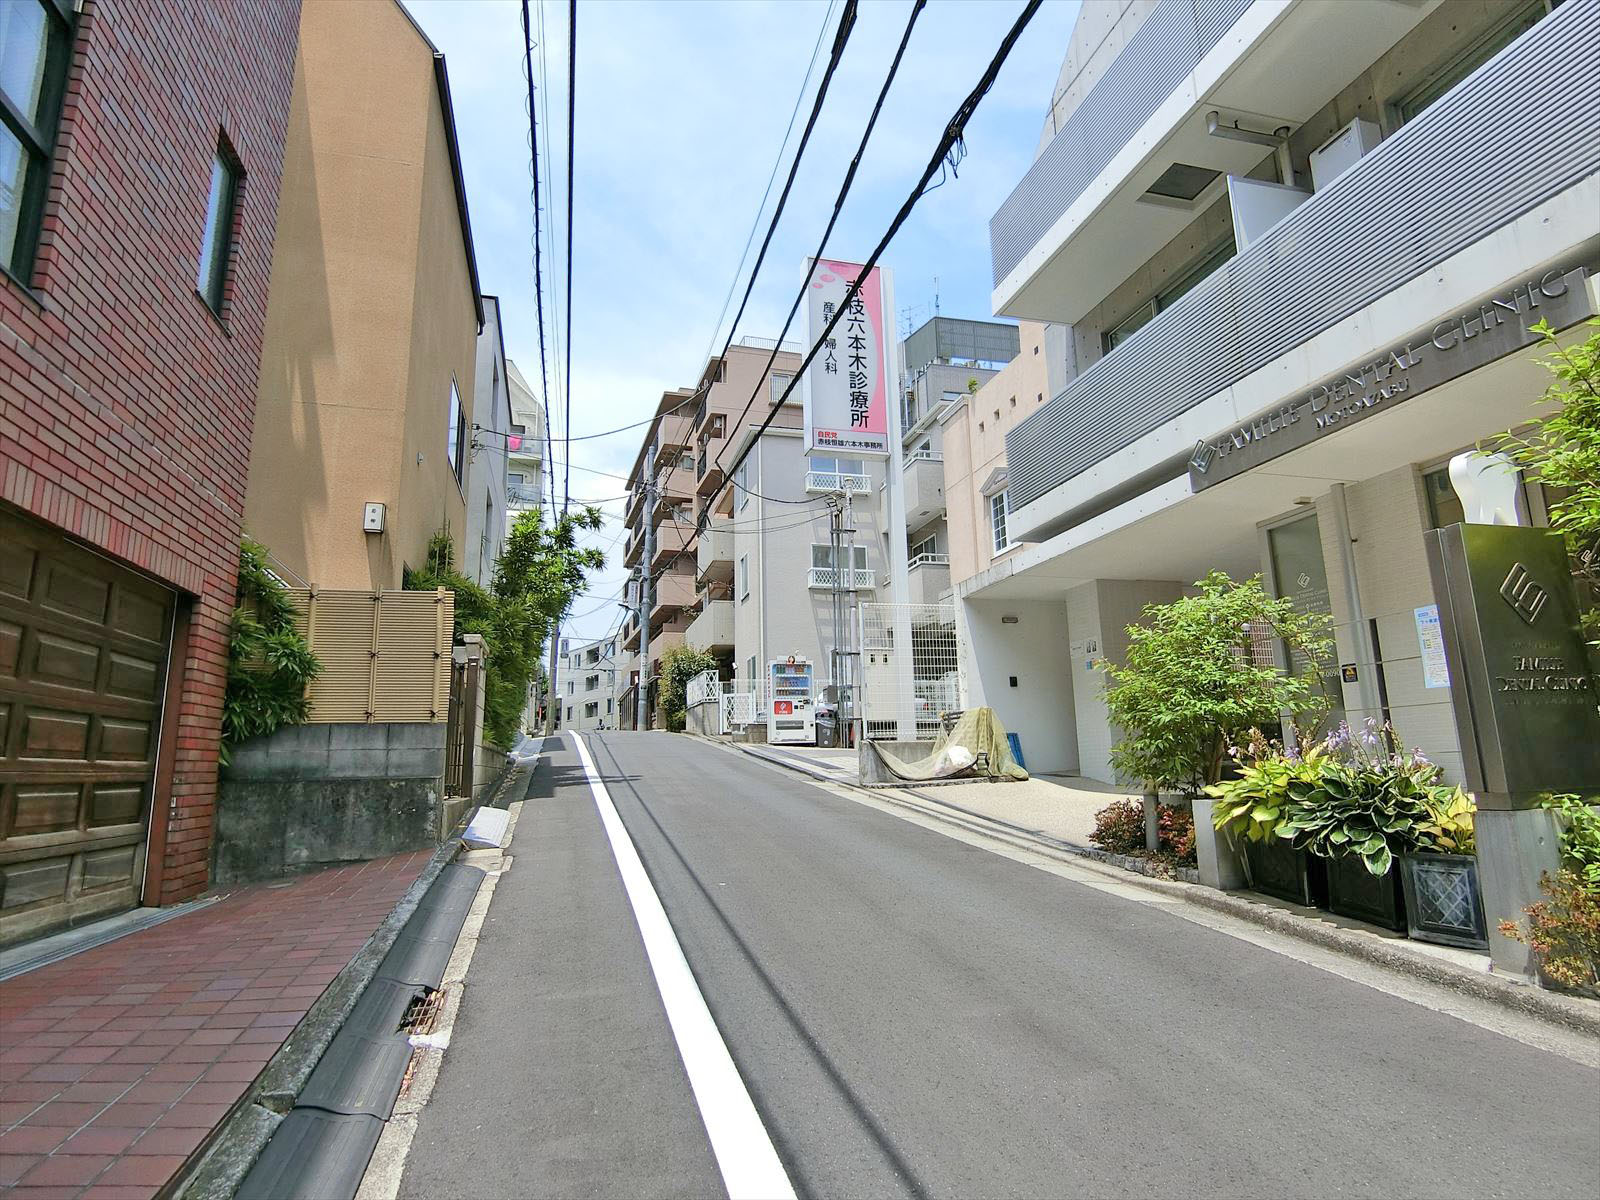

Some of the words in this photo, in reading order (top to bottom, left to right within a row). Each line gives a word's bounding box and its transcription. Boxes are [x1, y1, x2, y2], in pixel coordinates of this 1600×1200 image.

[845, 279, 870, 429] 赤枝六本木診療所
[1217, 403, 1301, 458] FAMILIE
[1309, 342, 1422, 414] DENTAL
[1431, 269, 1569, 351] CLINIC
[1315, 377, 1409, 431] MOTOAZABU
[817, 430, 838, 439] 自民党
